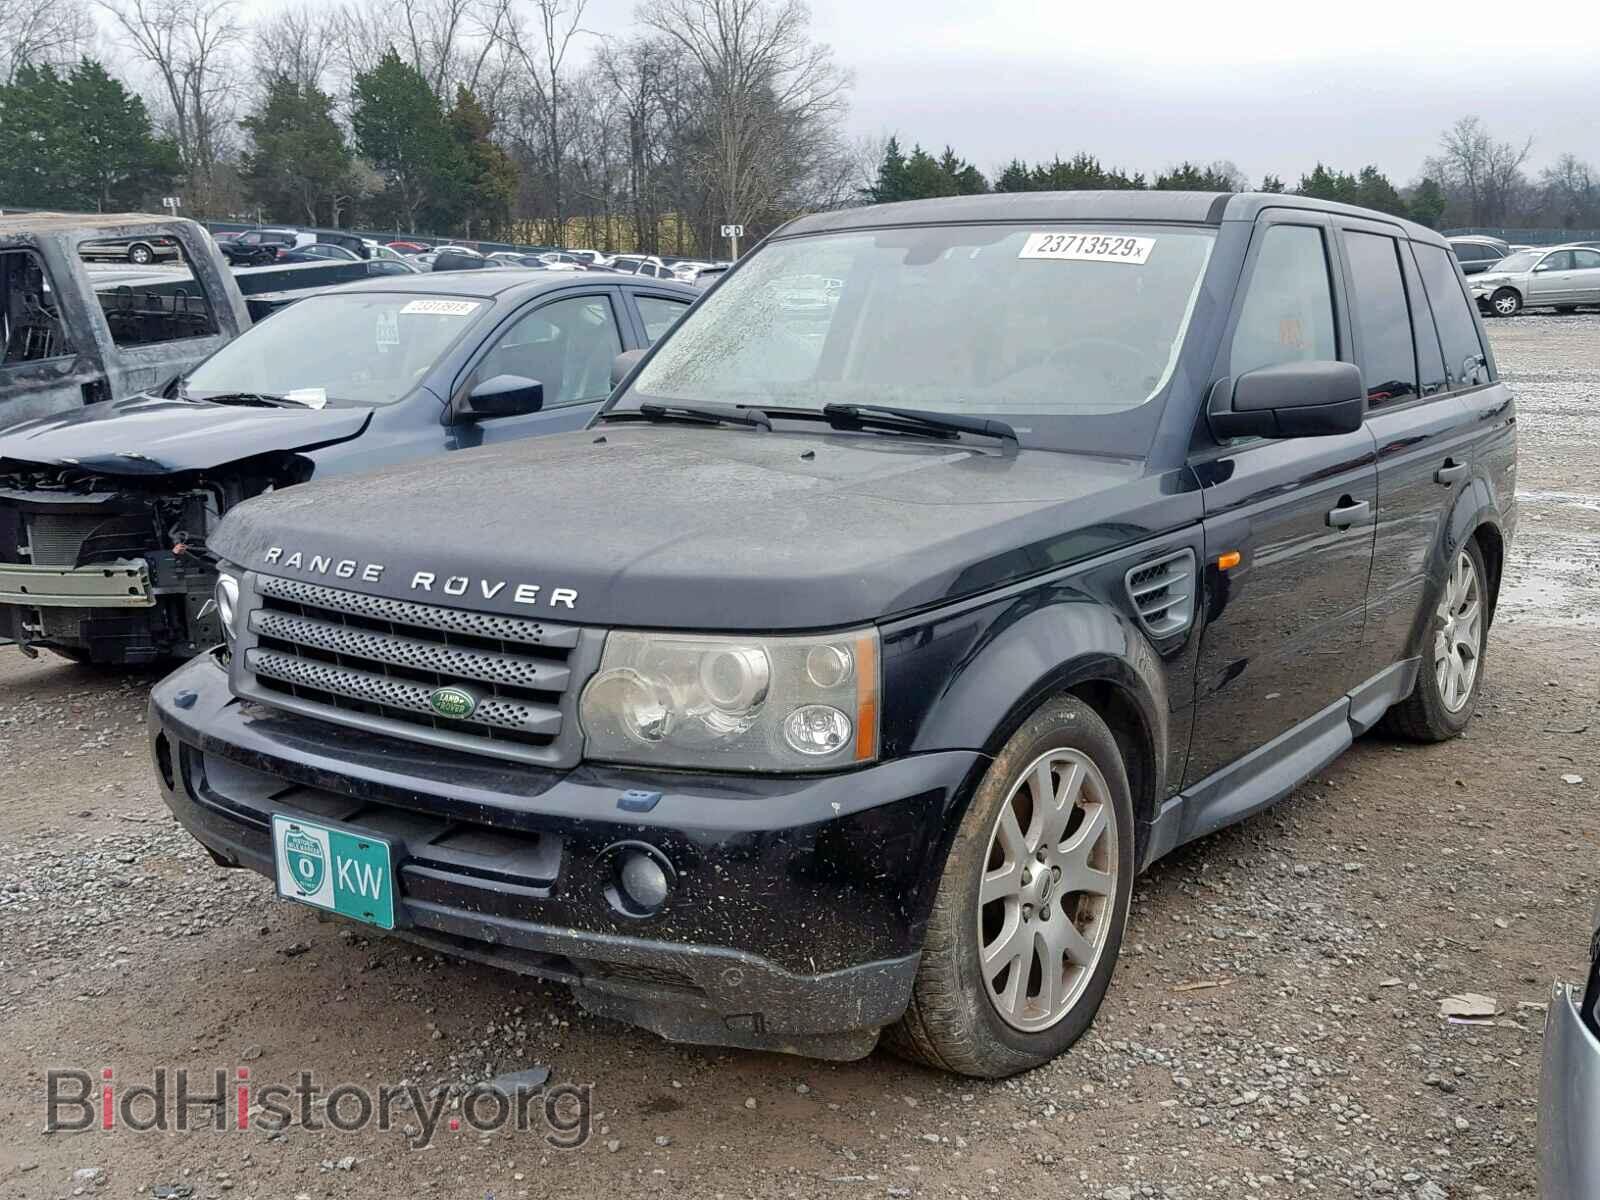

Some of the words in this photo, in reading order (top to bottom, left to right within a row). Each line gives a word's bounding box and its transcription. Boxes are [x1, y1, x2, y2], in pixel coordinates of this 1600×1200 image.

[723, 226, 731, 236] C
[734, 226, 741, 236] D
[264, 547, 384, 582] RANGE
[411, 572, 578, 609] ROVER
[440, 693, 460, 704] LAND
[440, 702, 465, 713] ROVER
[337, 856, 383, 900] KW
